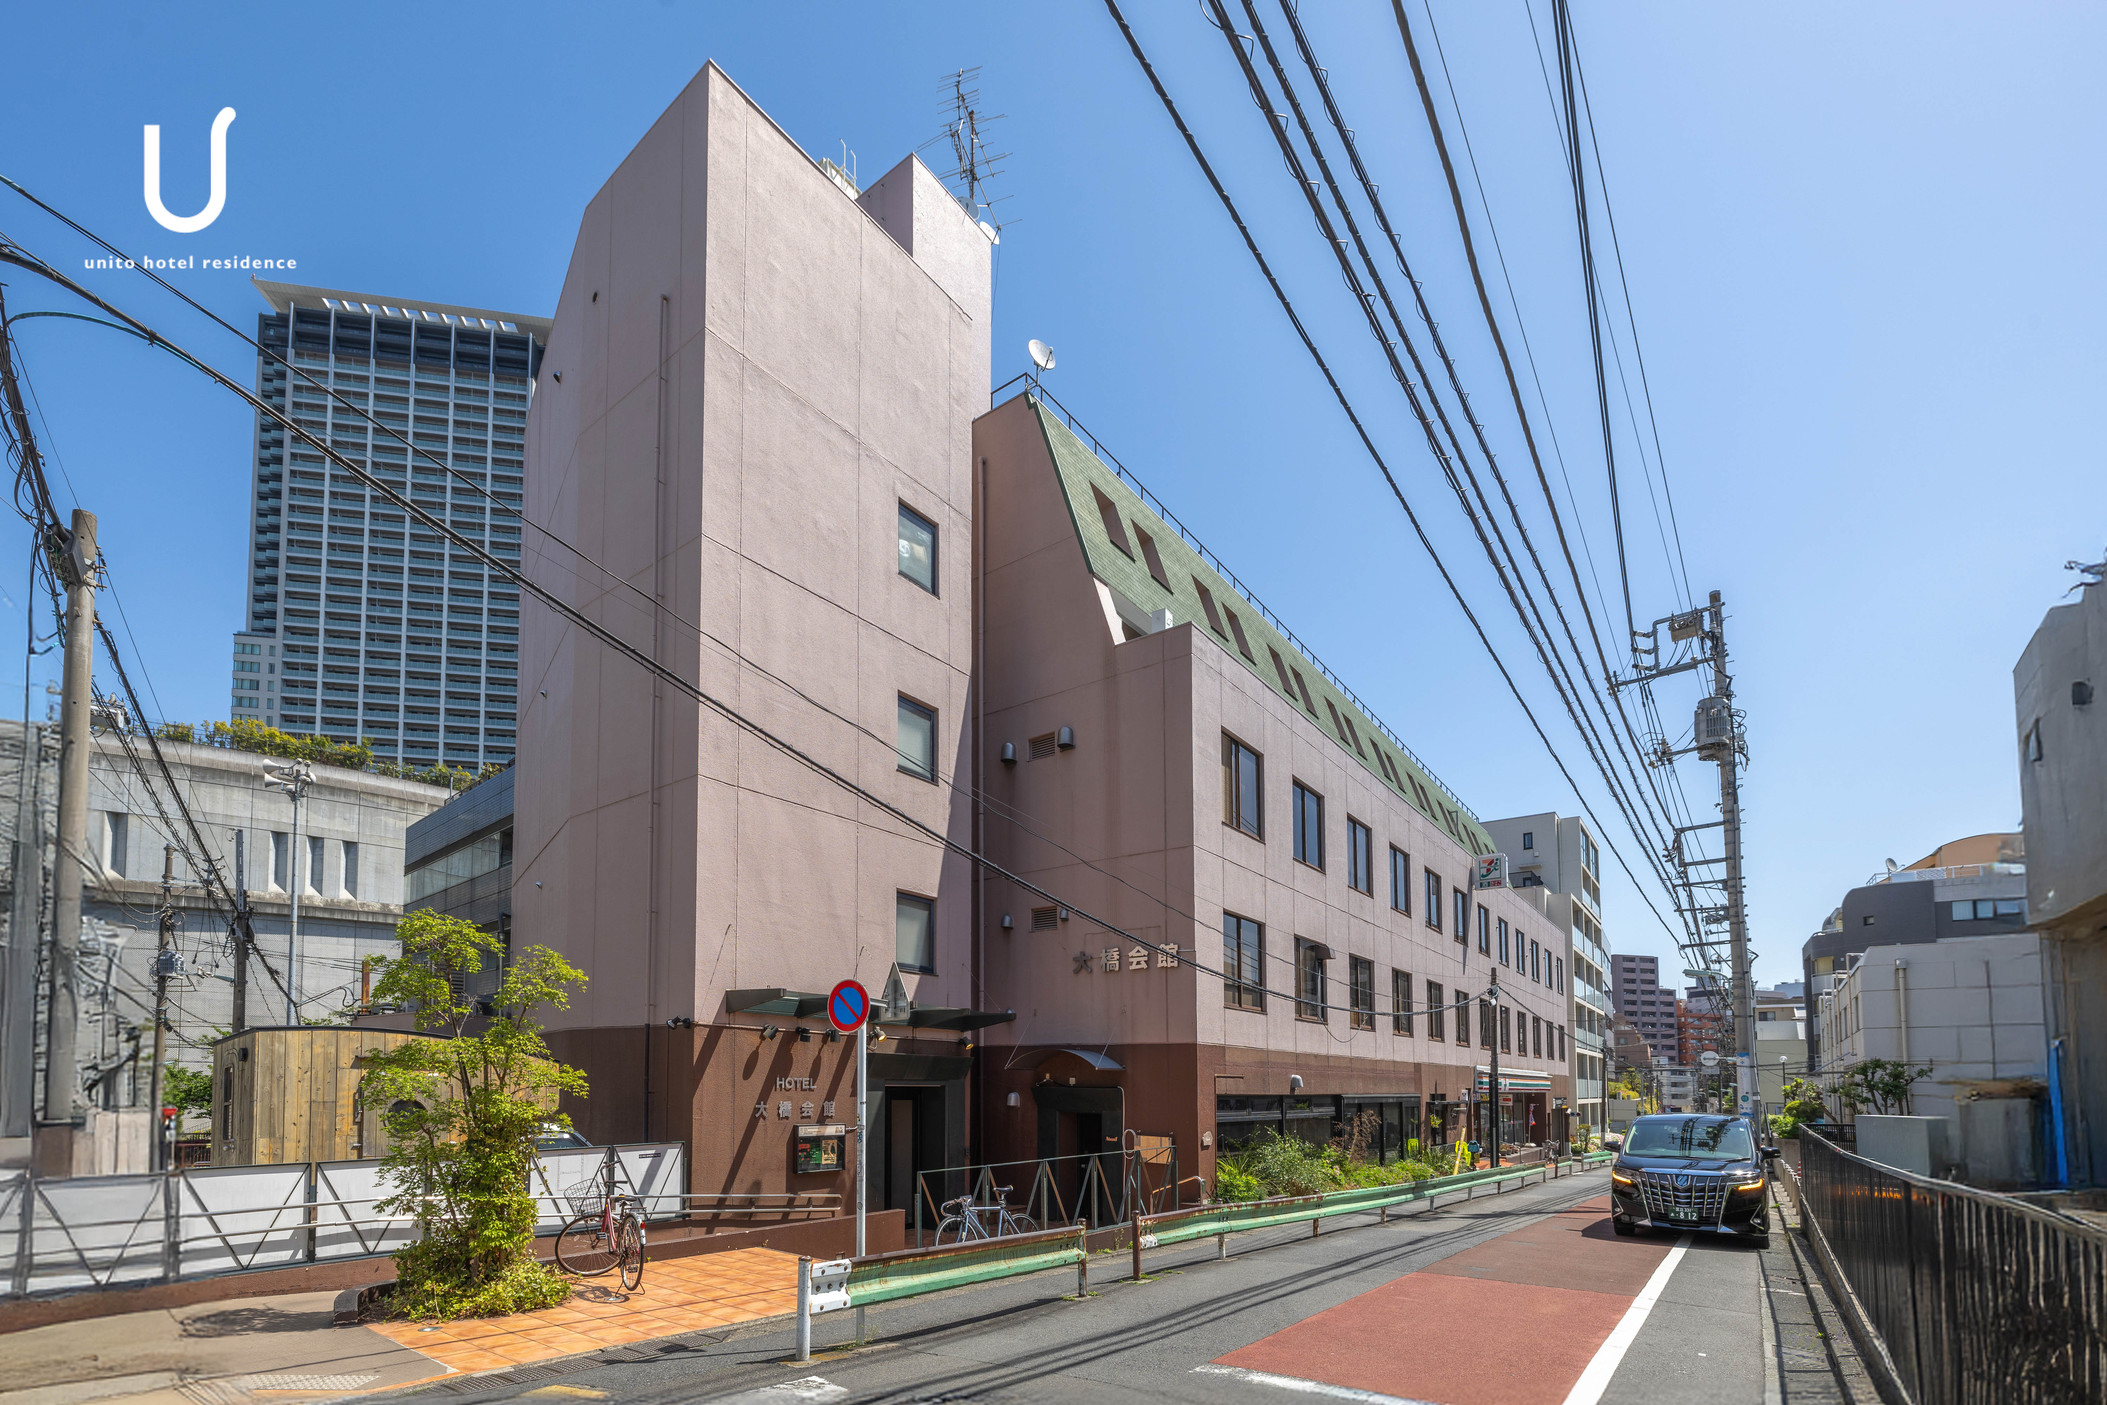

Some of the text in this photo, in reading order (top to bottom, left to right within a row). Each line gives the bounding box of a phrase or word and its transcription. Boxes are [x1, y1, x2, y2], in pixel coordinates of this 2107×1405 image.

[1072, 943, 1179, 974] 大橋会館
[776, 1077, 817, 1089] HOTEL
[755, 1101, 836, 1118] 大橋会館
